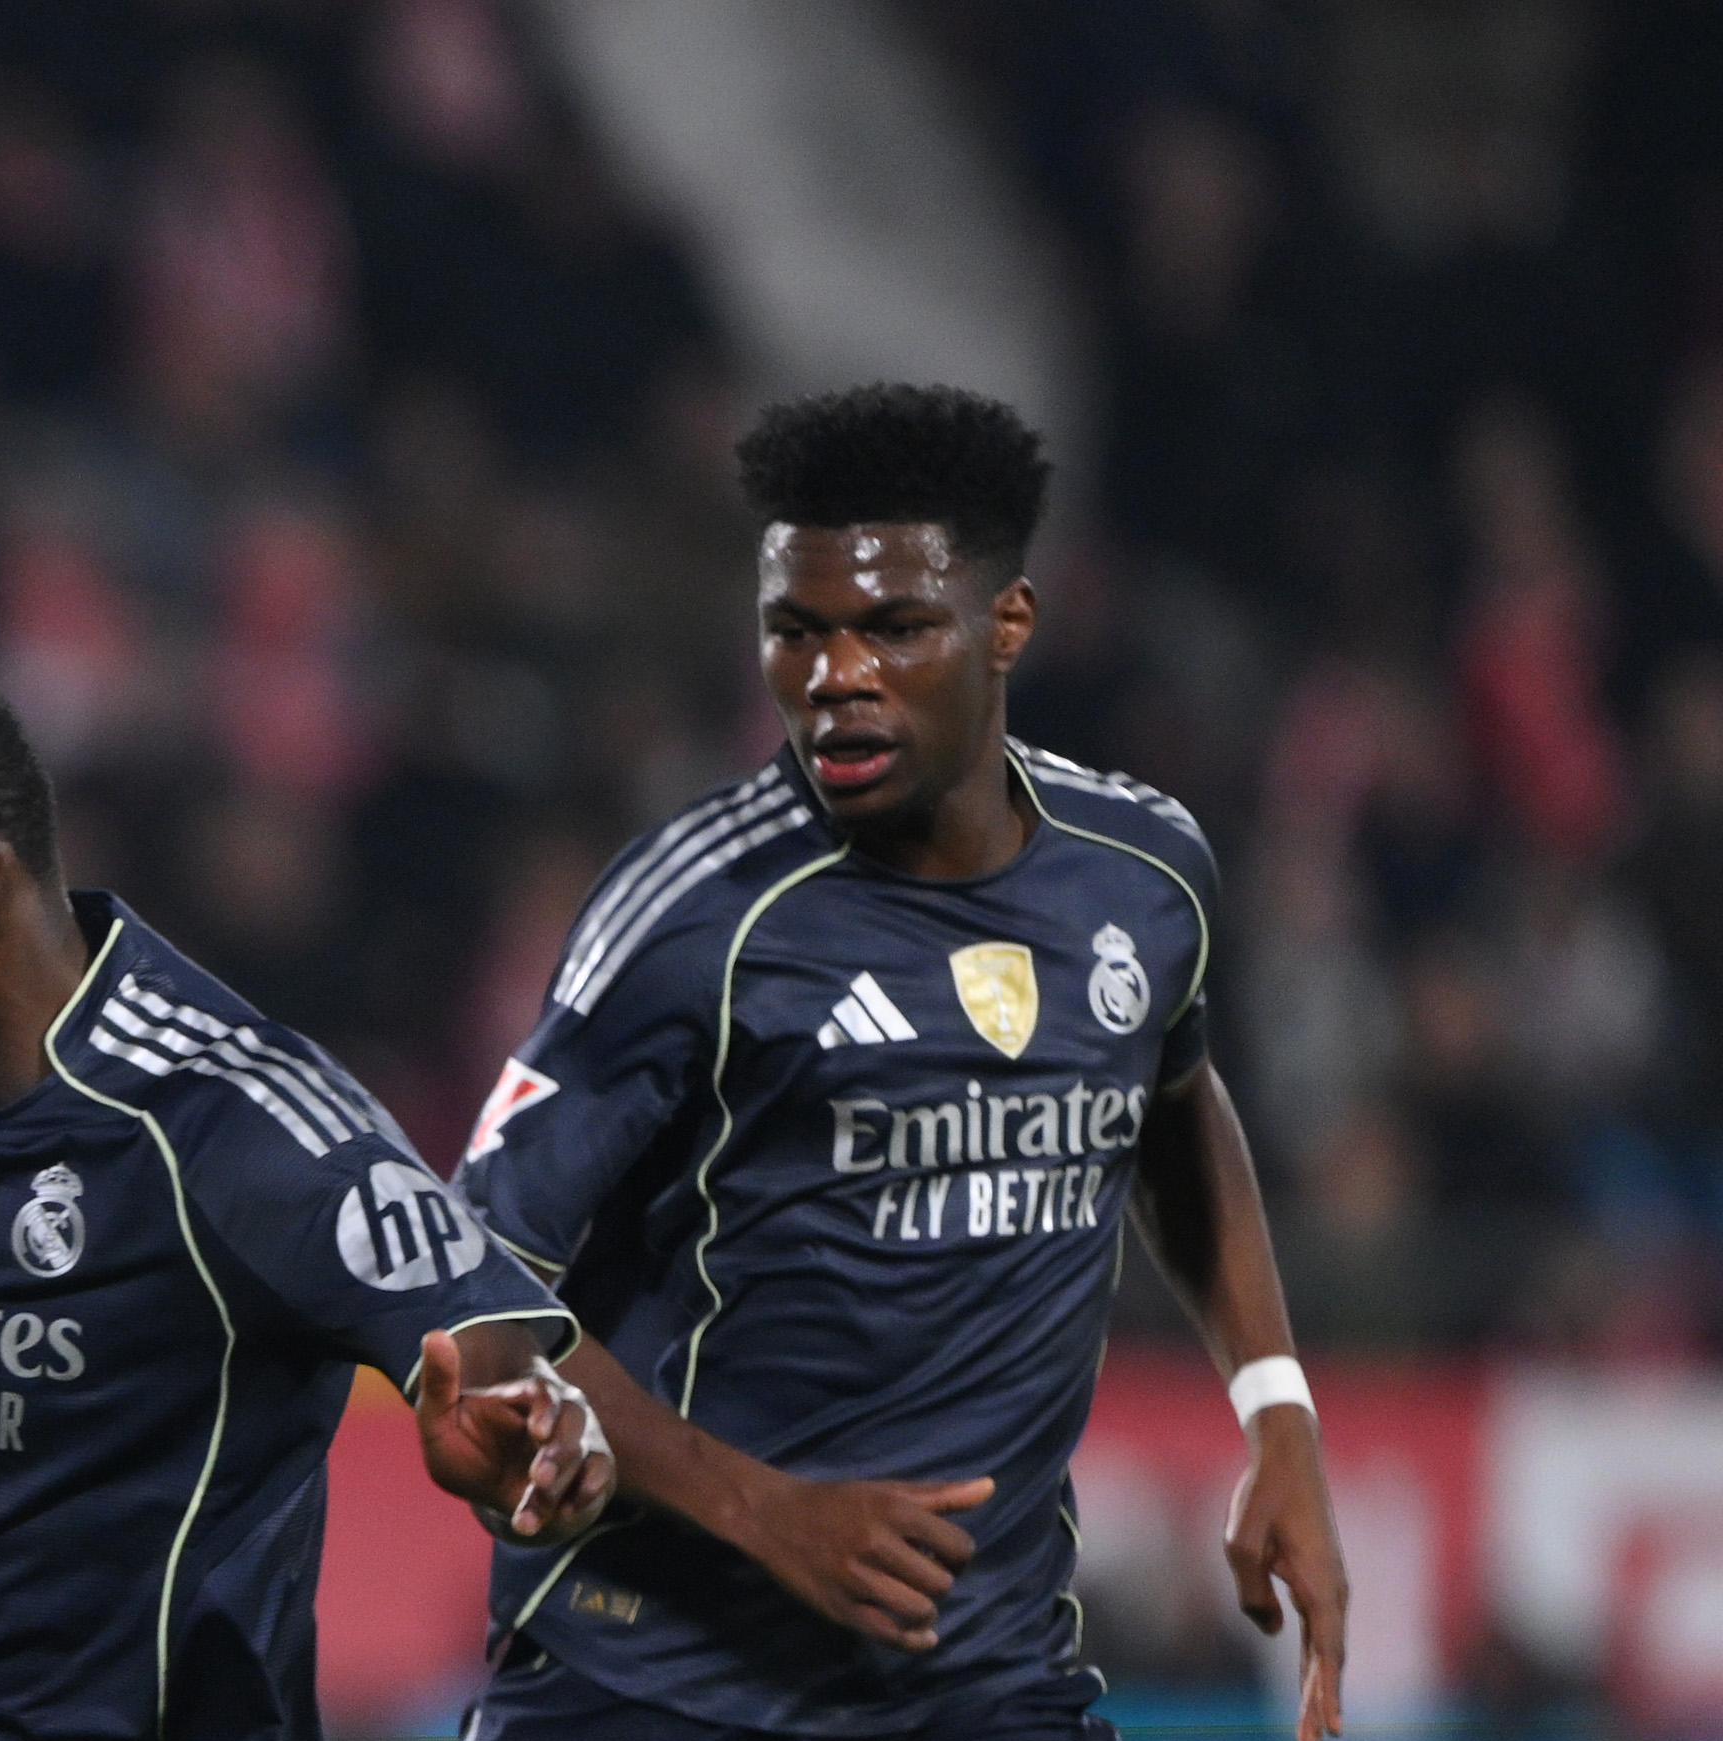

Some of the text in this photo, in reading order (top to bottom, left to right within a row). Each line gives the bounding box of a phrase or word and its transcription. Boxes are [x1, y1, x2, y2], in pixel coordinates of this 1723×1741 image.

[828, 1078, 1148, 1173] Emirates
[353, 1164, 463, 1283] hp
[873, 1164, 1104, 1240] FLY BETTER
